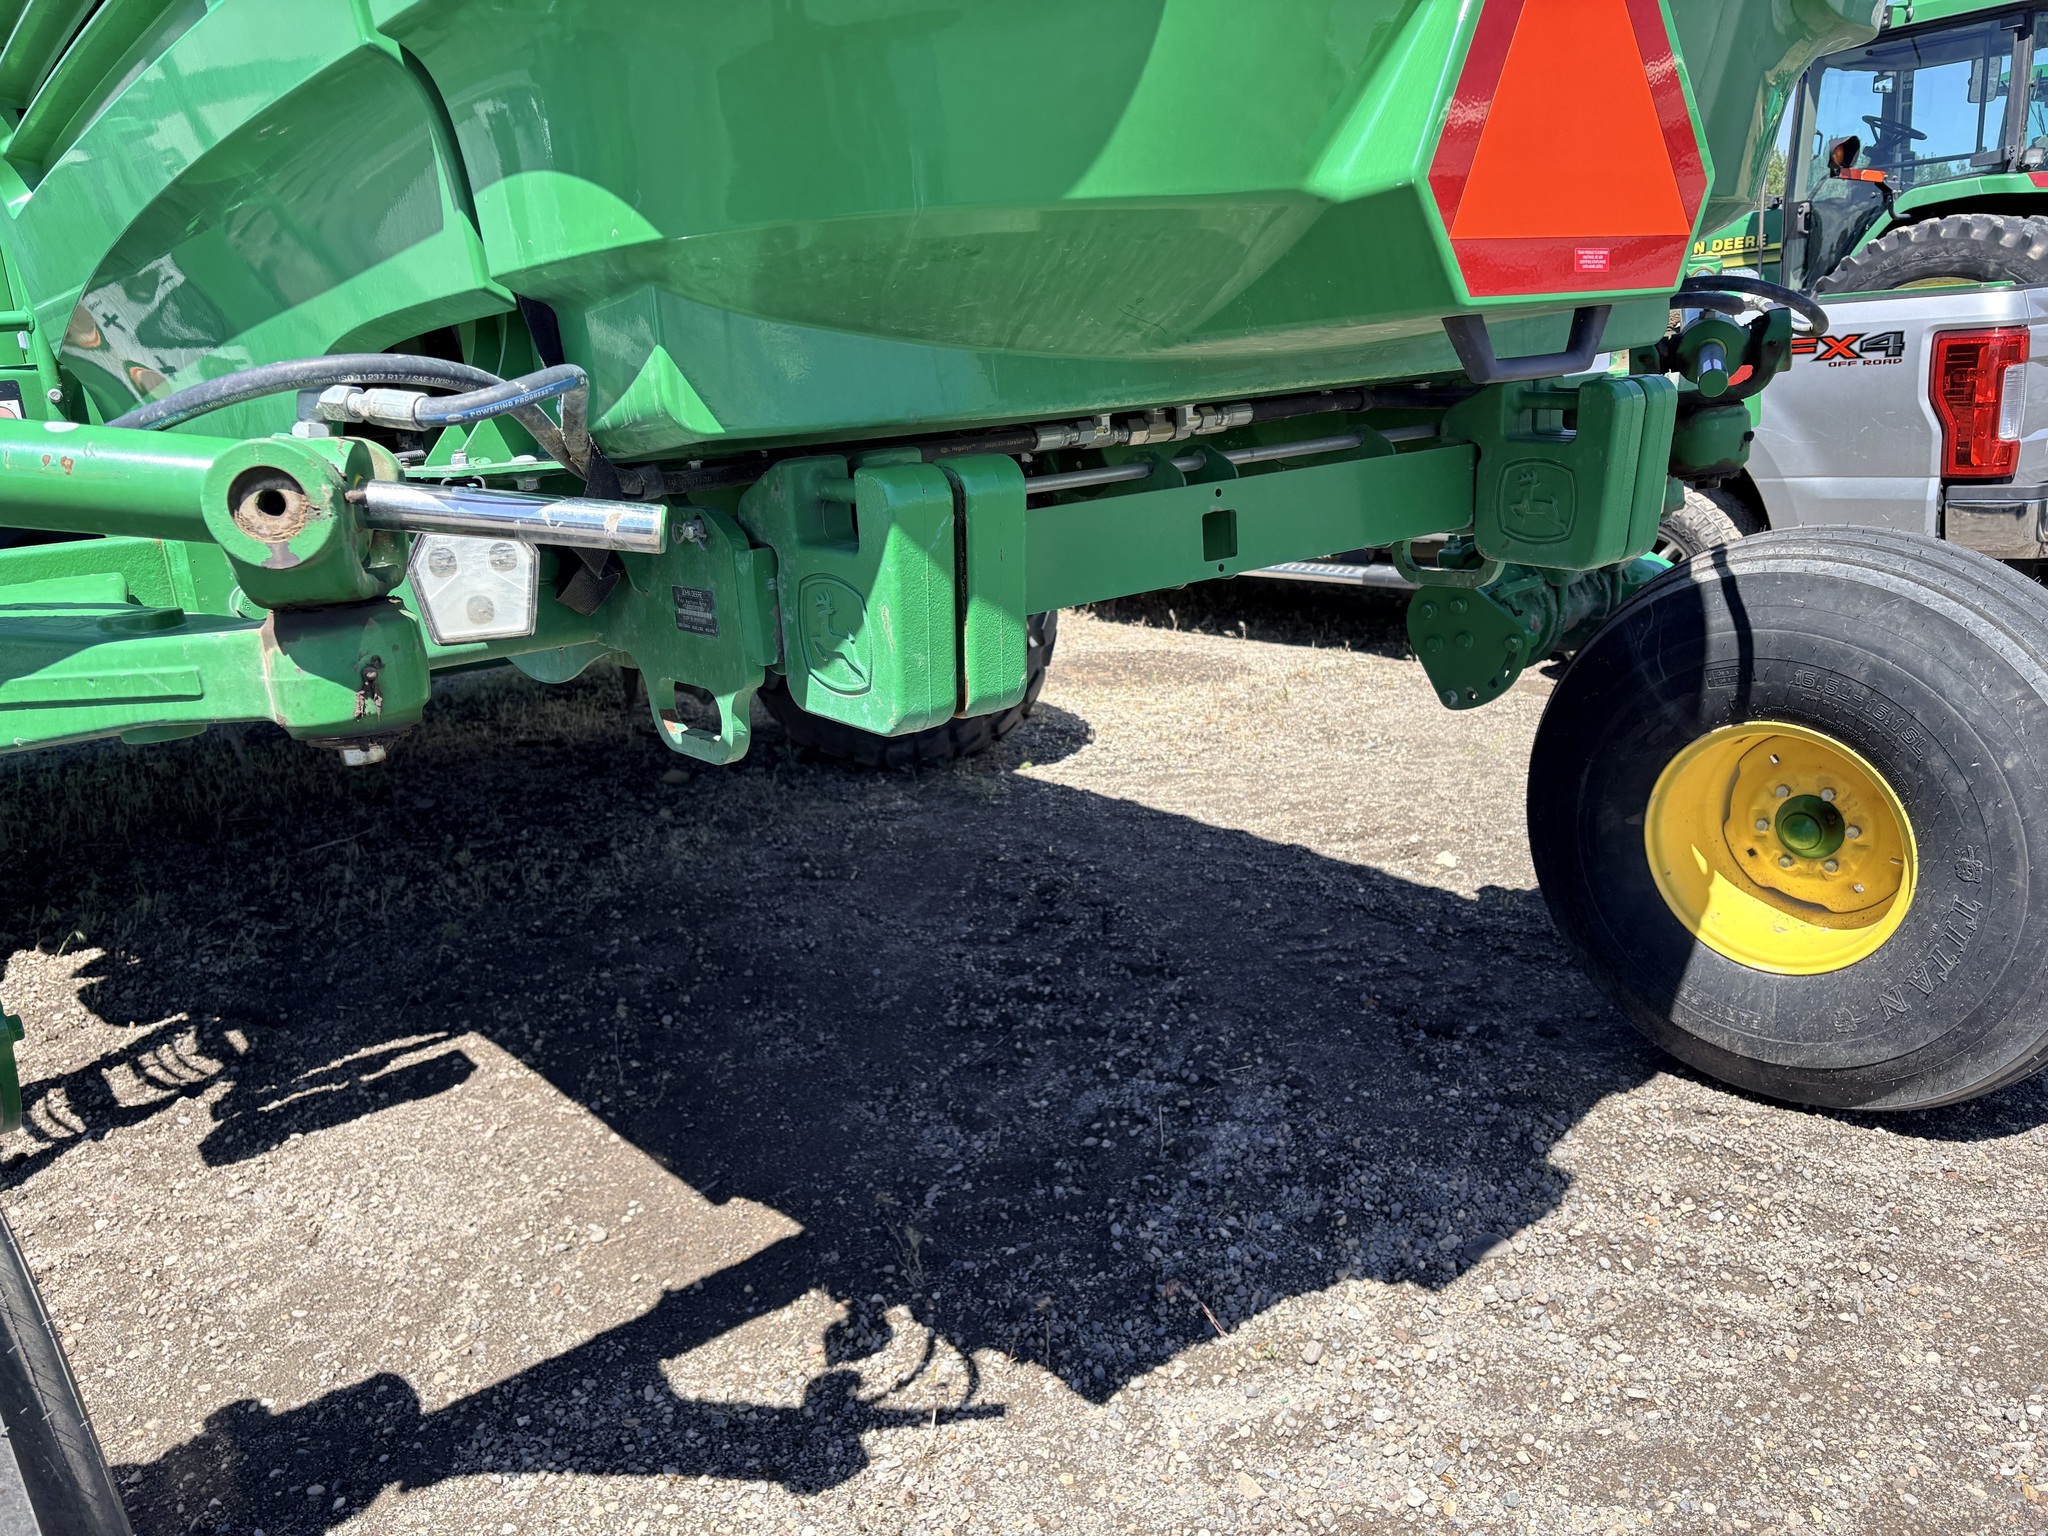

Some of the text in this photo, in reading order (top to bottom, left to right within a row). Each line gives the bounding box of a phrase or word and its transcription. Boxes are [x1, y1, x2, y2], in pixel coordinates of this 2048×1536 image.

[1711, 234, 1767, 253] DEERE
[1828, 358, 1903, 368] OFF ROAD
[356, 373, 385, 382] 11237
[387, 373, 405, 382] R17
[470, 401, 514, 418] POWERING
[1878, 894, 1983, 1022] TITAN
